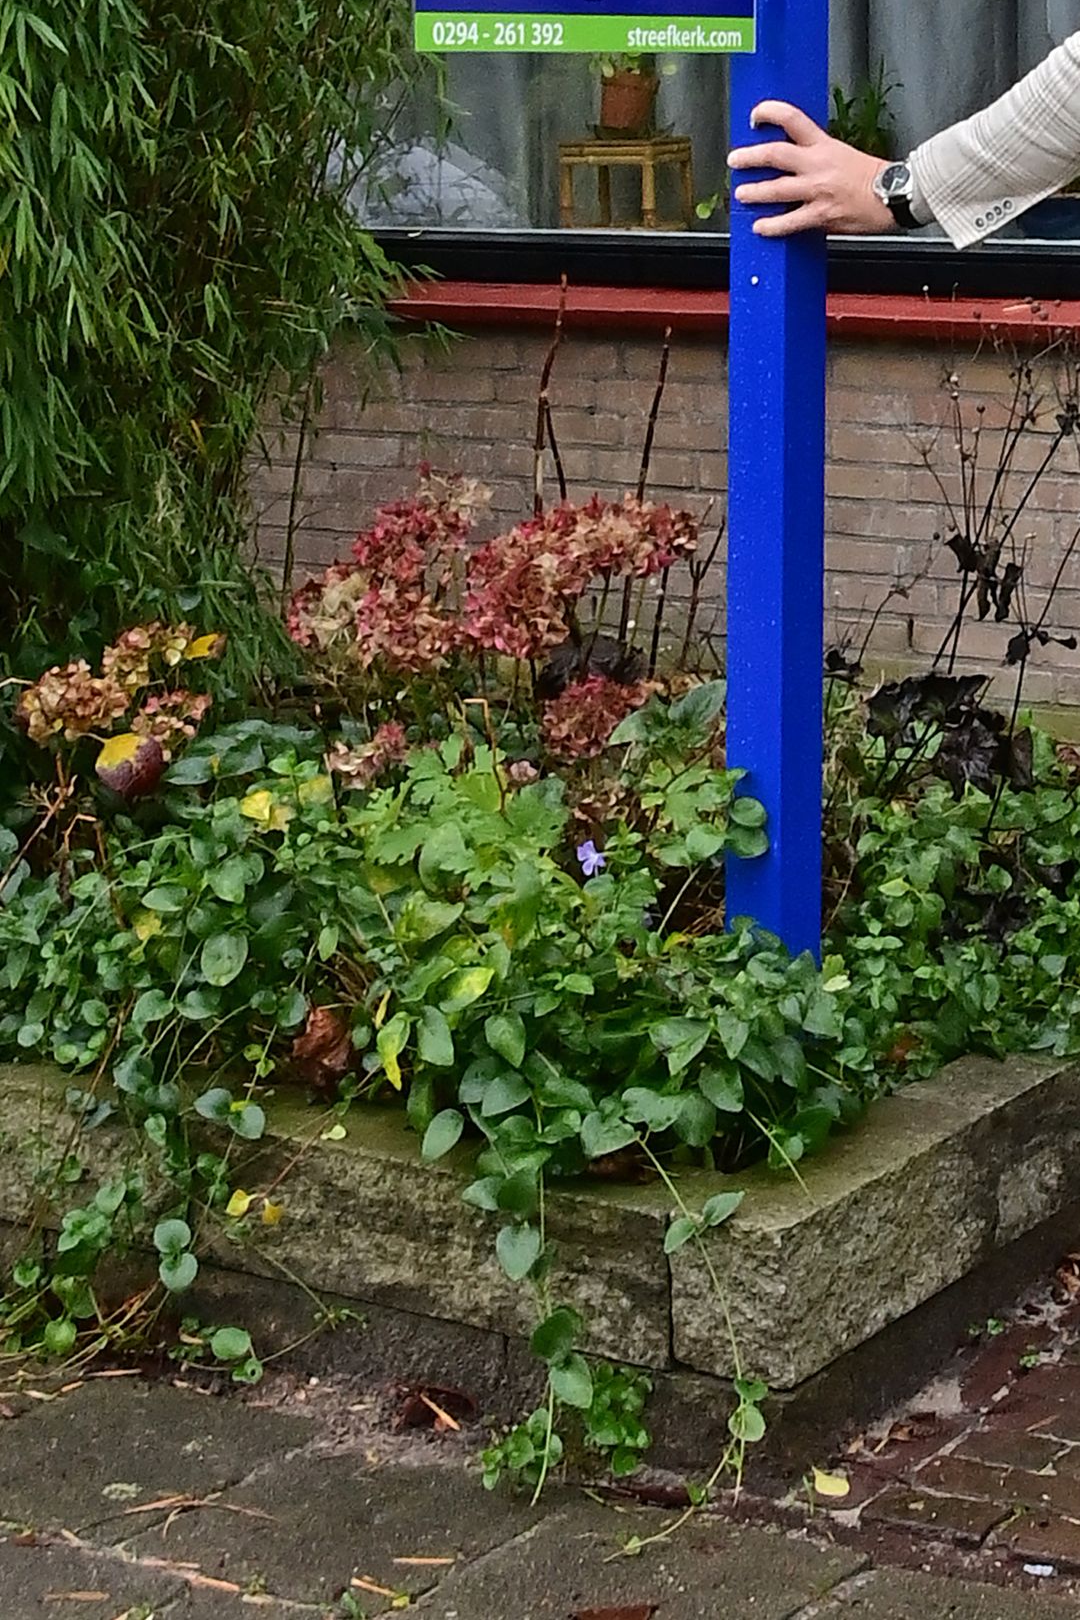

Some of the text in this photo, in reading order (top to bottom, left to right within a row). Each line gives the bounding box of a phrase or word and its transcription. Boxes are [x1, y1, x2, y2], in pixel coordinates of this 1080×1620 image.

[432, 21, 479, 46] 0294
[494, 22, 525, 46] 261
[531, 23, 564, 46] 392
[627, 25, 742, 48] streefkerk.com
